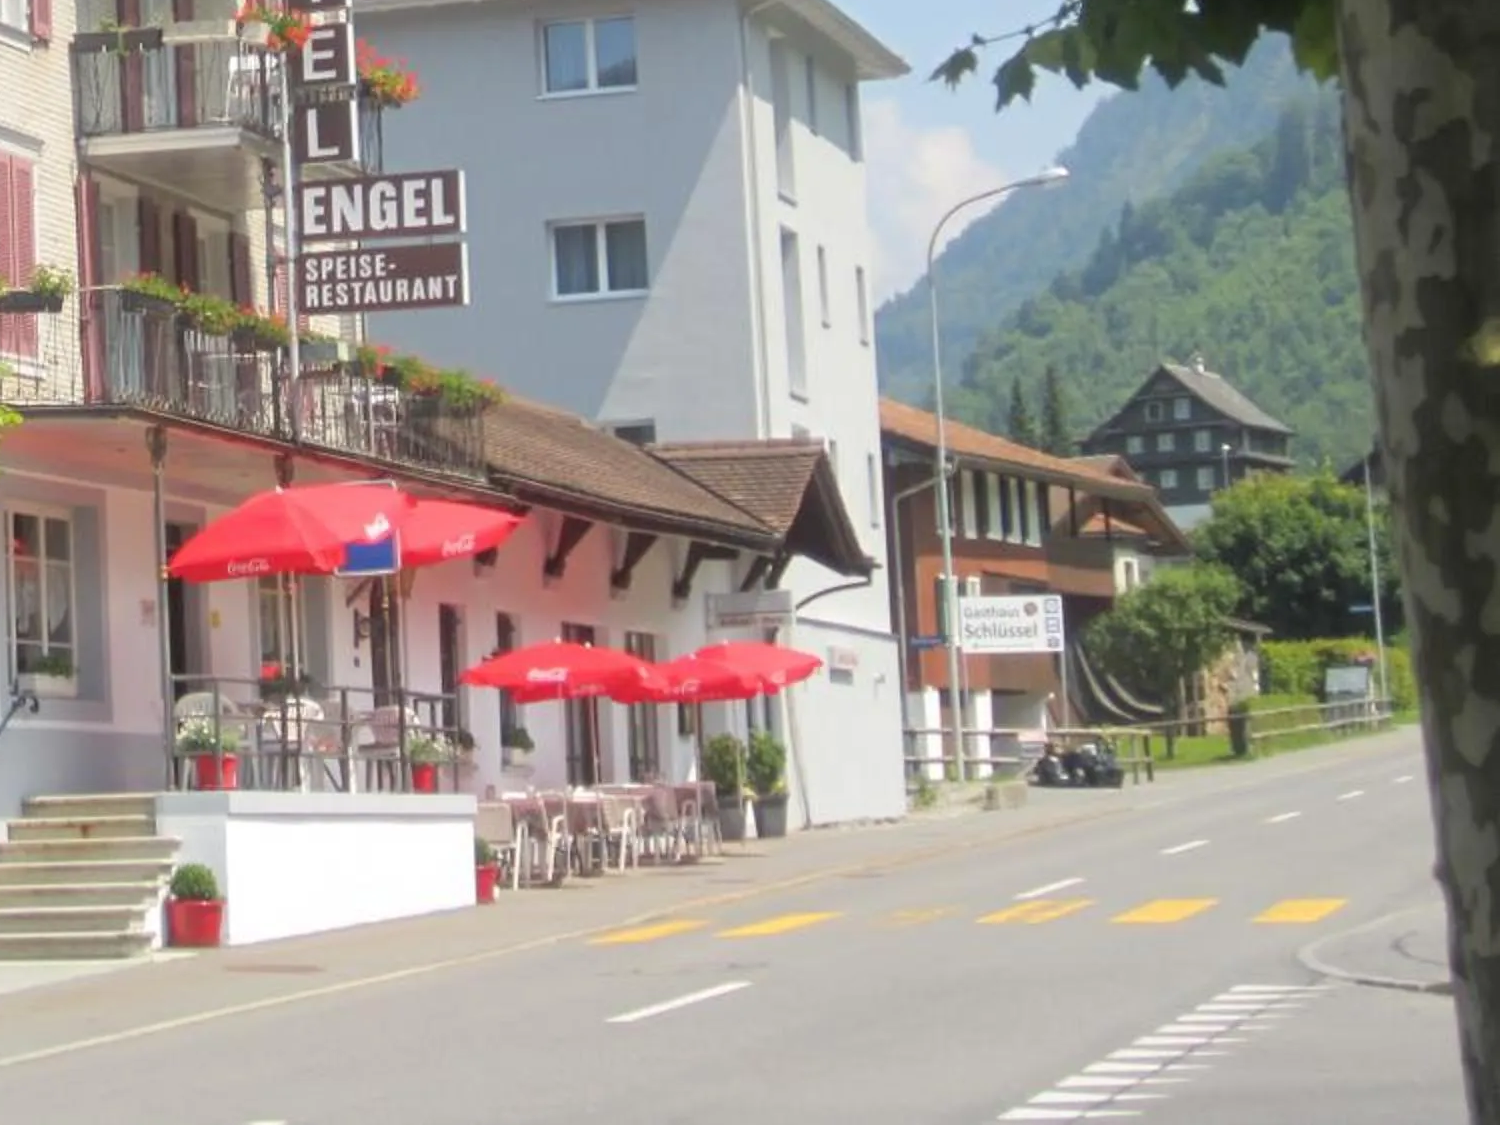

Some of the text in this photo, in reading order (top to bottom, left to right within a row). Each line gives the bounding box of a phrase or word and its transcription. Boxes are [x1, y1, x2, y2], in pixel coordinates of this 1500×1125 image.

[303, 178, 456, 235] ENGEL
[305, 253, 397, 282] SPEISE-
[305, 275, 458, 309] RESTAURANT
[964, 621, 1038, 640] Schlüssel
